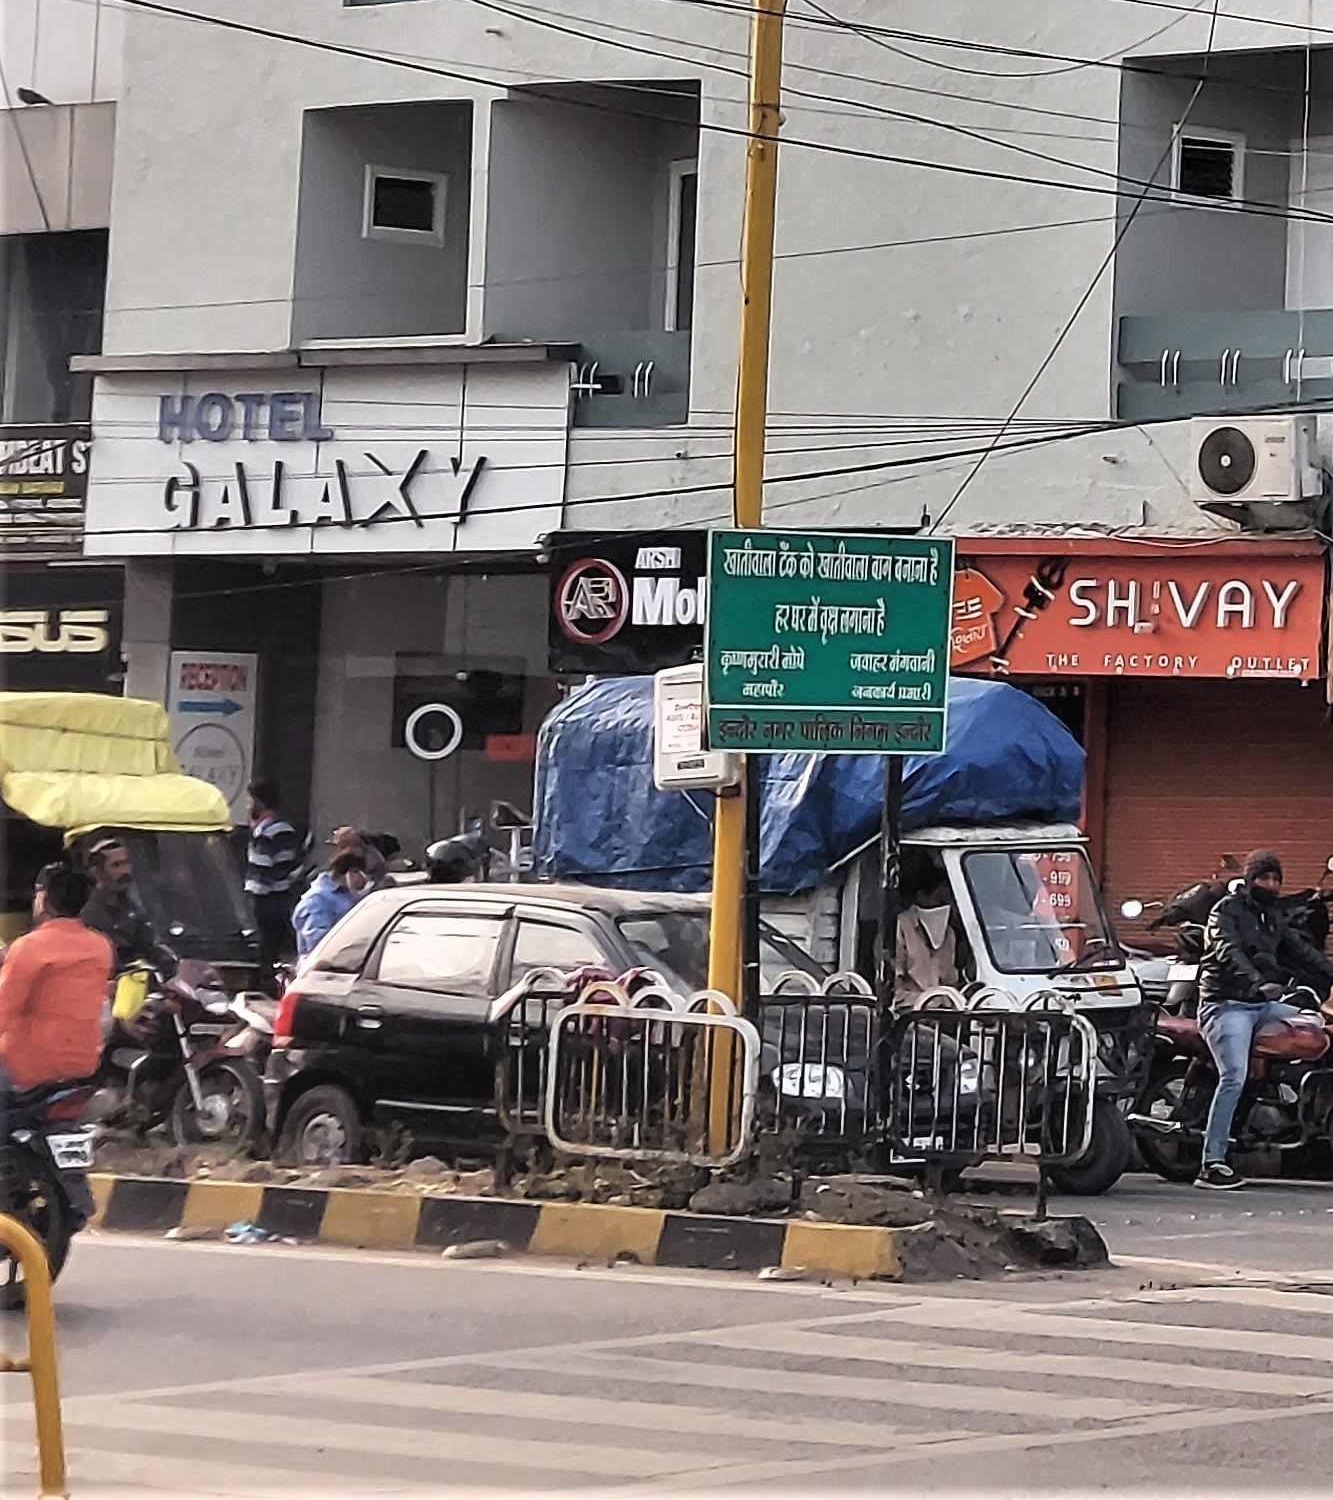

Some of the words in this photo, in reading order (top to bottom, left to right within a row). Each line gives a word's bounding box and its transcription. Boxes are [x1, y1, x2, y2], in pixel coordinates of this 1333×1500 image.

[158, 391, 334, 444] HOTEL
[162, 448, 487, 529] GALAXY
[799, 541, 813, 580] को
[929, 547, 939, 587] है
[1046, 653, 1080, 668] THE
[1104, 654, 1199, 669] FACTORY
[1231, 656, 1311, 672] OUTLET
